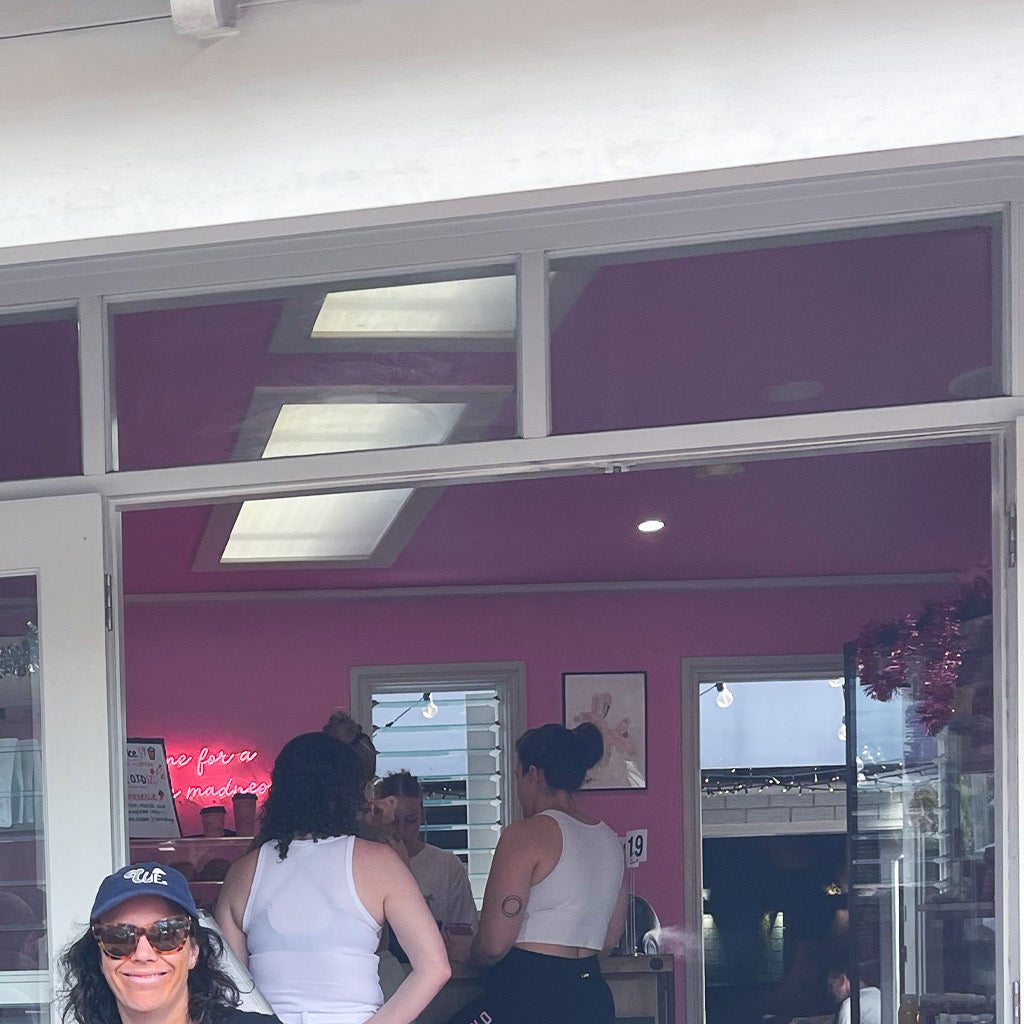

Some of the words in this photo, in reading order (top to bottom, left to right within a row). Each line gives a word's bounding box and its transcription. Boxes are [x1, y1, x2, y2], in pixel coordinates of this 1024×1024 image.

[197, 747, 234, 776] for
[239, 750, 257, 763] a
[186, 778, 273, 800] madnes
[627, 834, 644, 858] 19
